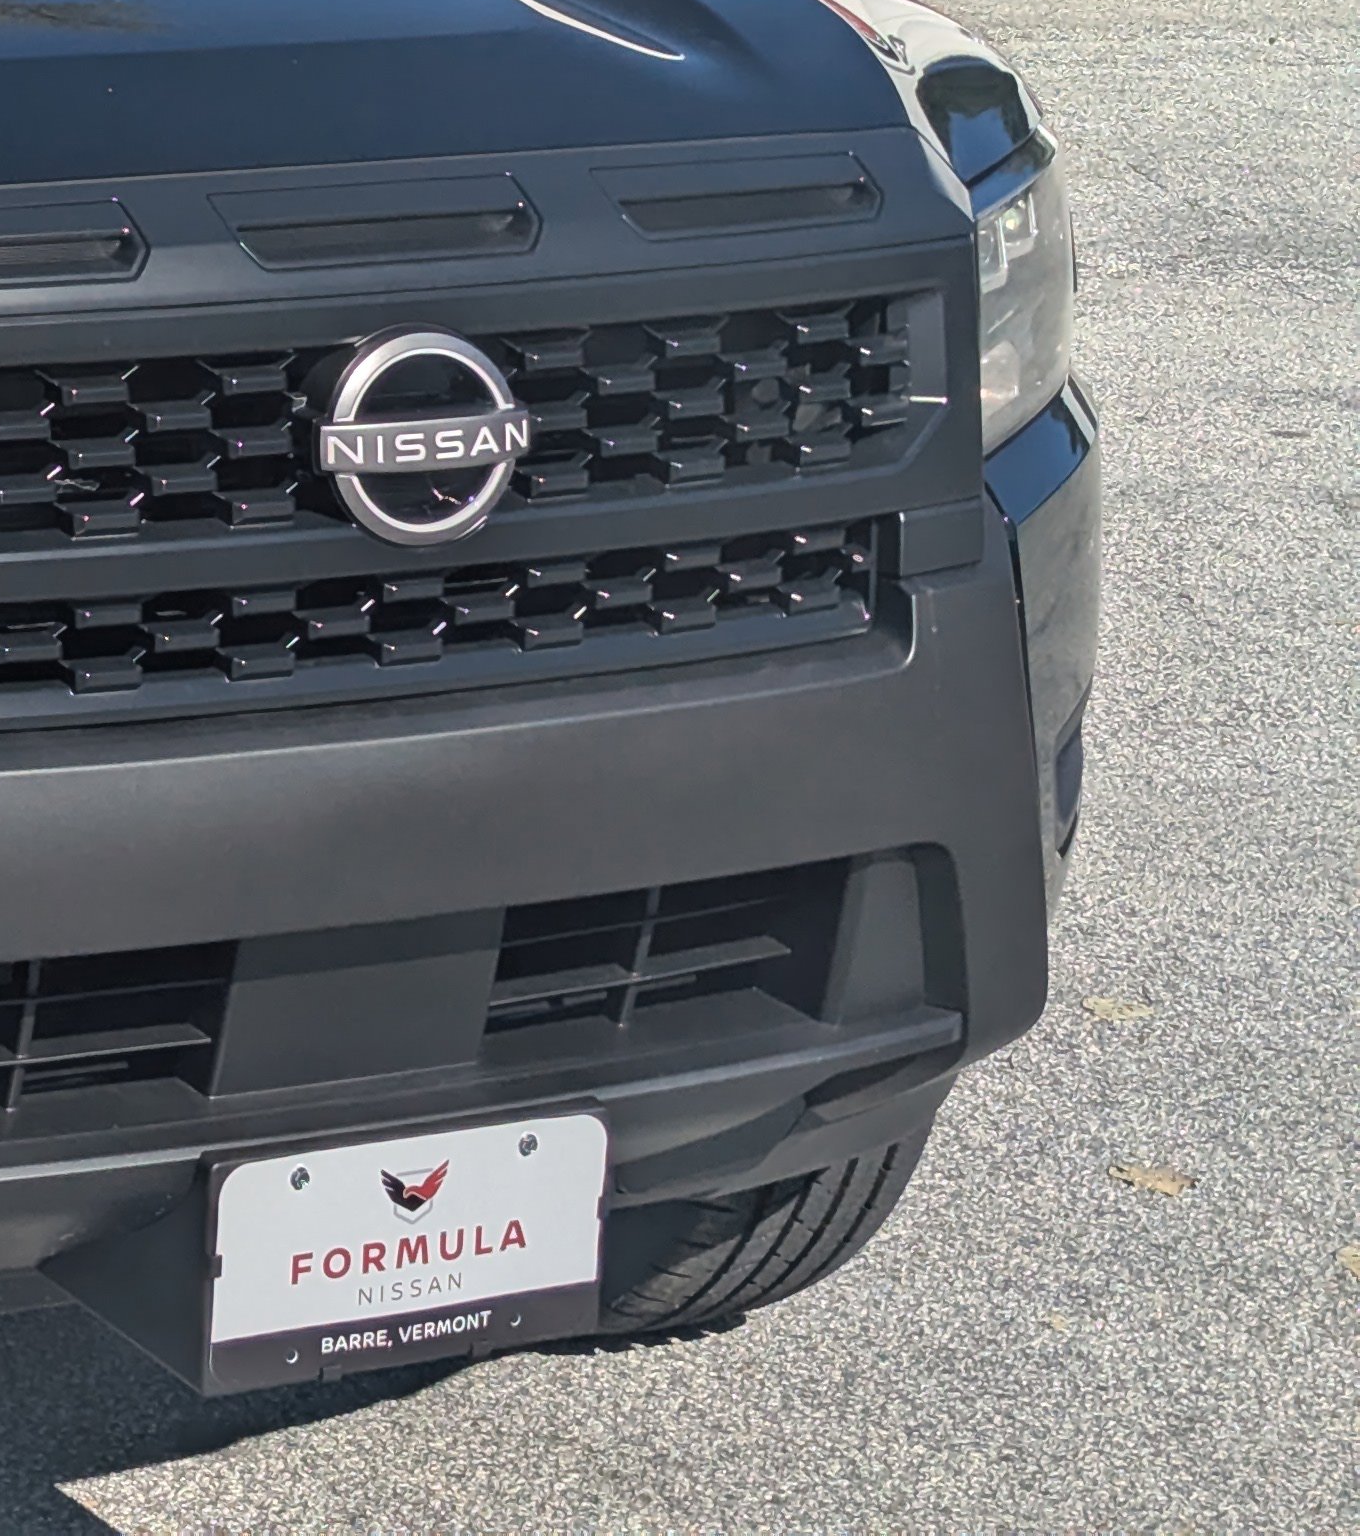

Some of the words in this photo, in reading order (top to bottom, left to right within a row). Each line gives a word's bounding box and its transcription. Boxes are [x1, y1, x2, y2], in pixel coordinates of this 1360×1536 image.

[327, 418, 528, 465] NISSAN
[290, 1219, 528, 1286] FORMULA
[357, 1272, 464, 1306] NISSAN
[320, 1329, 394, 1356] BARRE,
[398, 1310, 493, 1345] VERMONT
